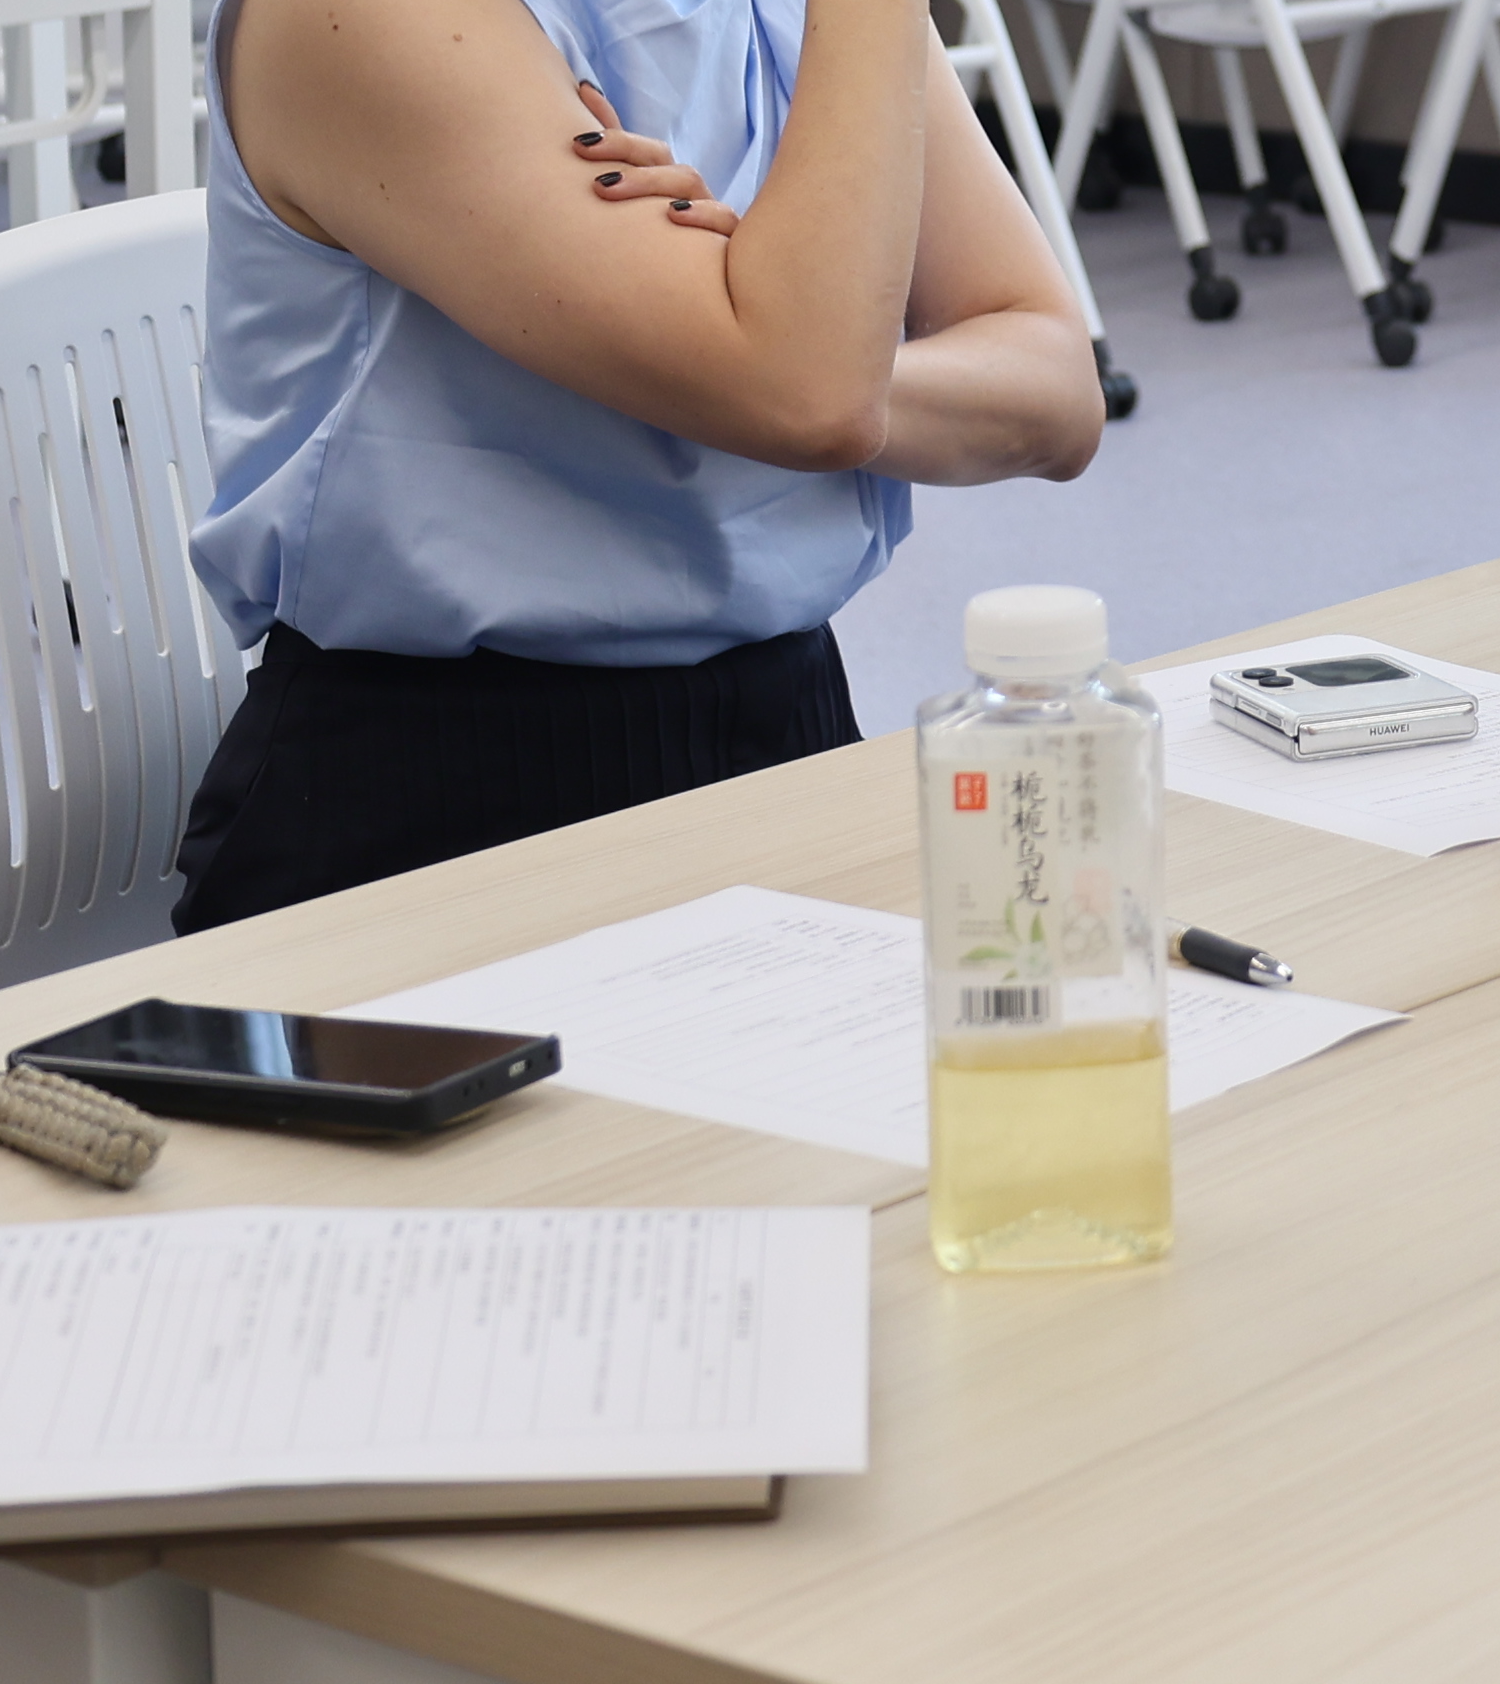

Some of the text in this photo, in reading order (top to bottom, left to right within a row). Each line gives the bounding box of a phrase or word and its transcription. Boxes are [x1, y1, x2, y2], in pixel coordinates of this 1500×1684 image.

[1369, 723, 1410, 736] HUAWEI
[1011, 770, 1049, 904] 栀栀乌龙
